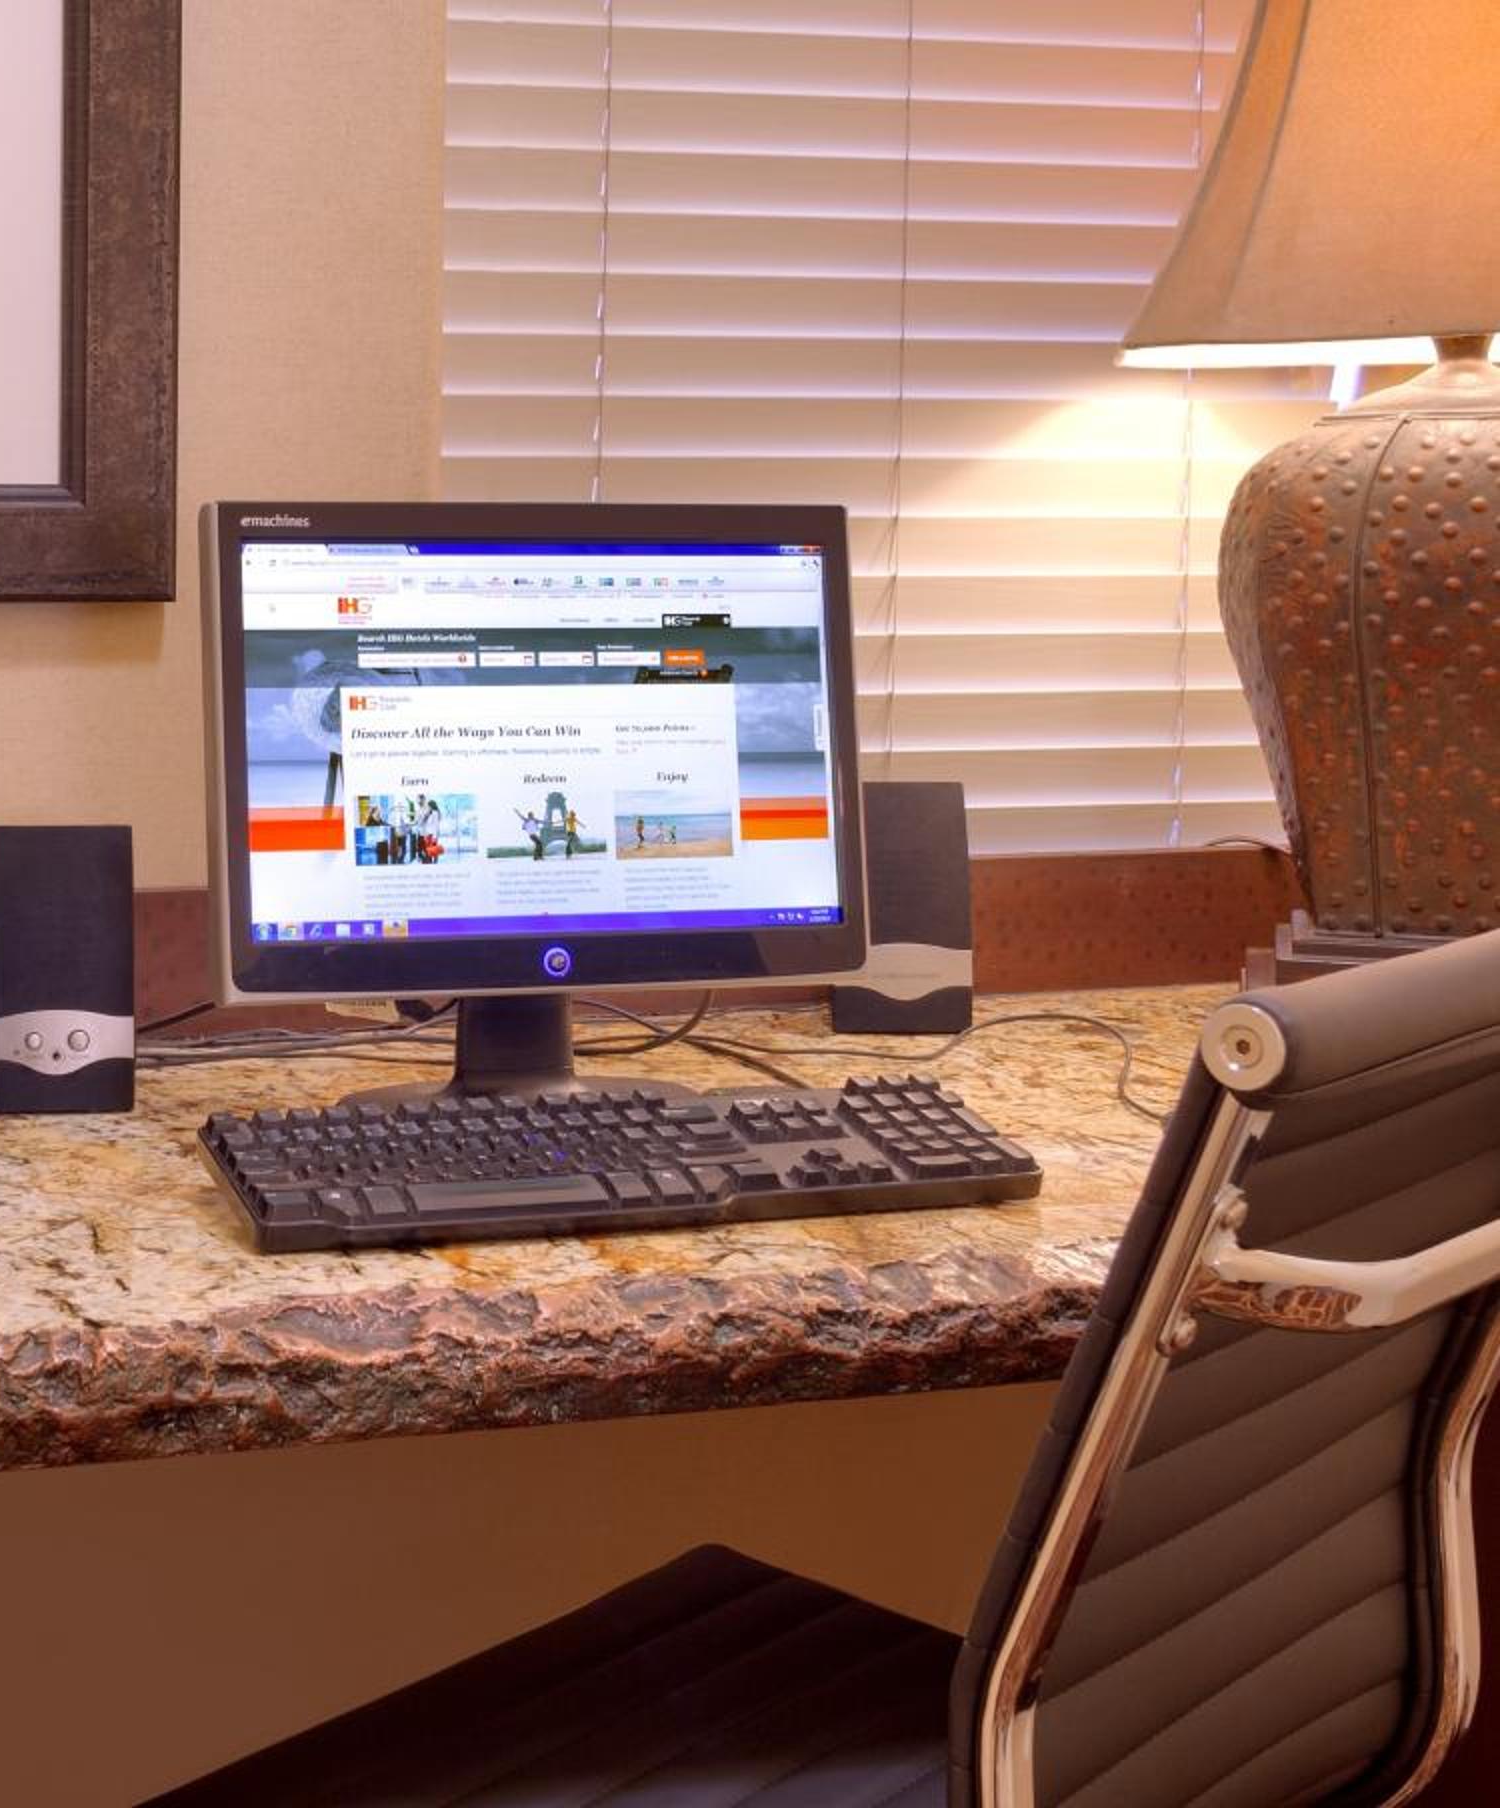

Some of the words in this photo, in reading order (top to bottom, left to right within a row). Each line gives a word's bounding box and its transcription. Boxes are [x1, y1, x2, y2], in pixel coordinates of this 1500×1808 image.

[240, 514, 310, 527] emachines
[351, 727, 409, 740] Discover
[410, 726, 431, 739] All
[433, 726, 455, 739] the
[457, 726, 496, 741] Ways
[498, 725, 523, 738] You
[525, 725, 551, 737] Can
[555, 725, 581, 737] Win
[400, 775, 429, 787] Earn
[523, 773, 568, 785] Redeem
[656, 771, 689, 784] Enjoy
